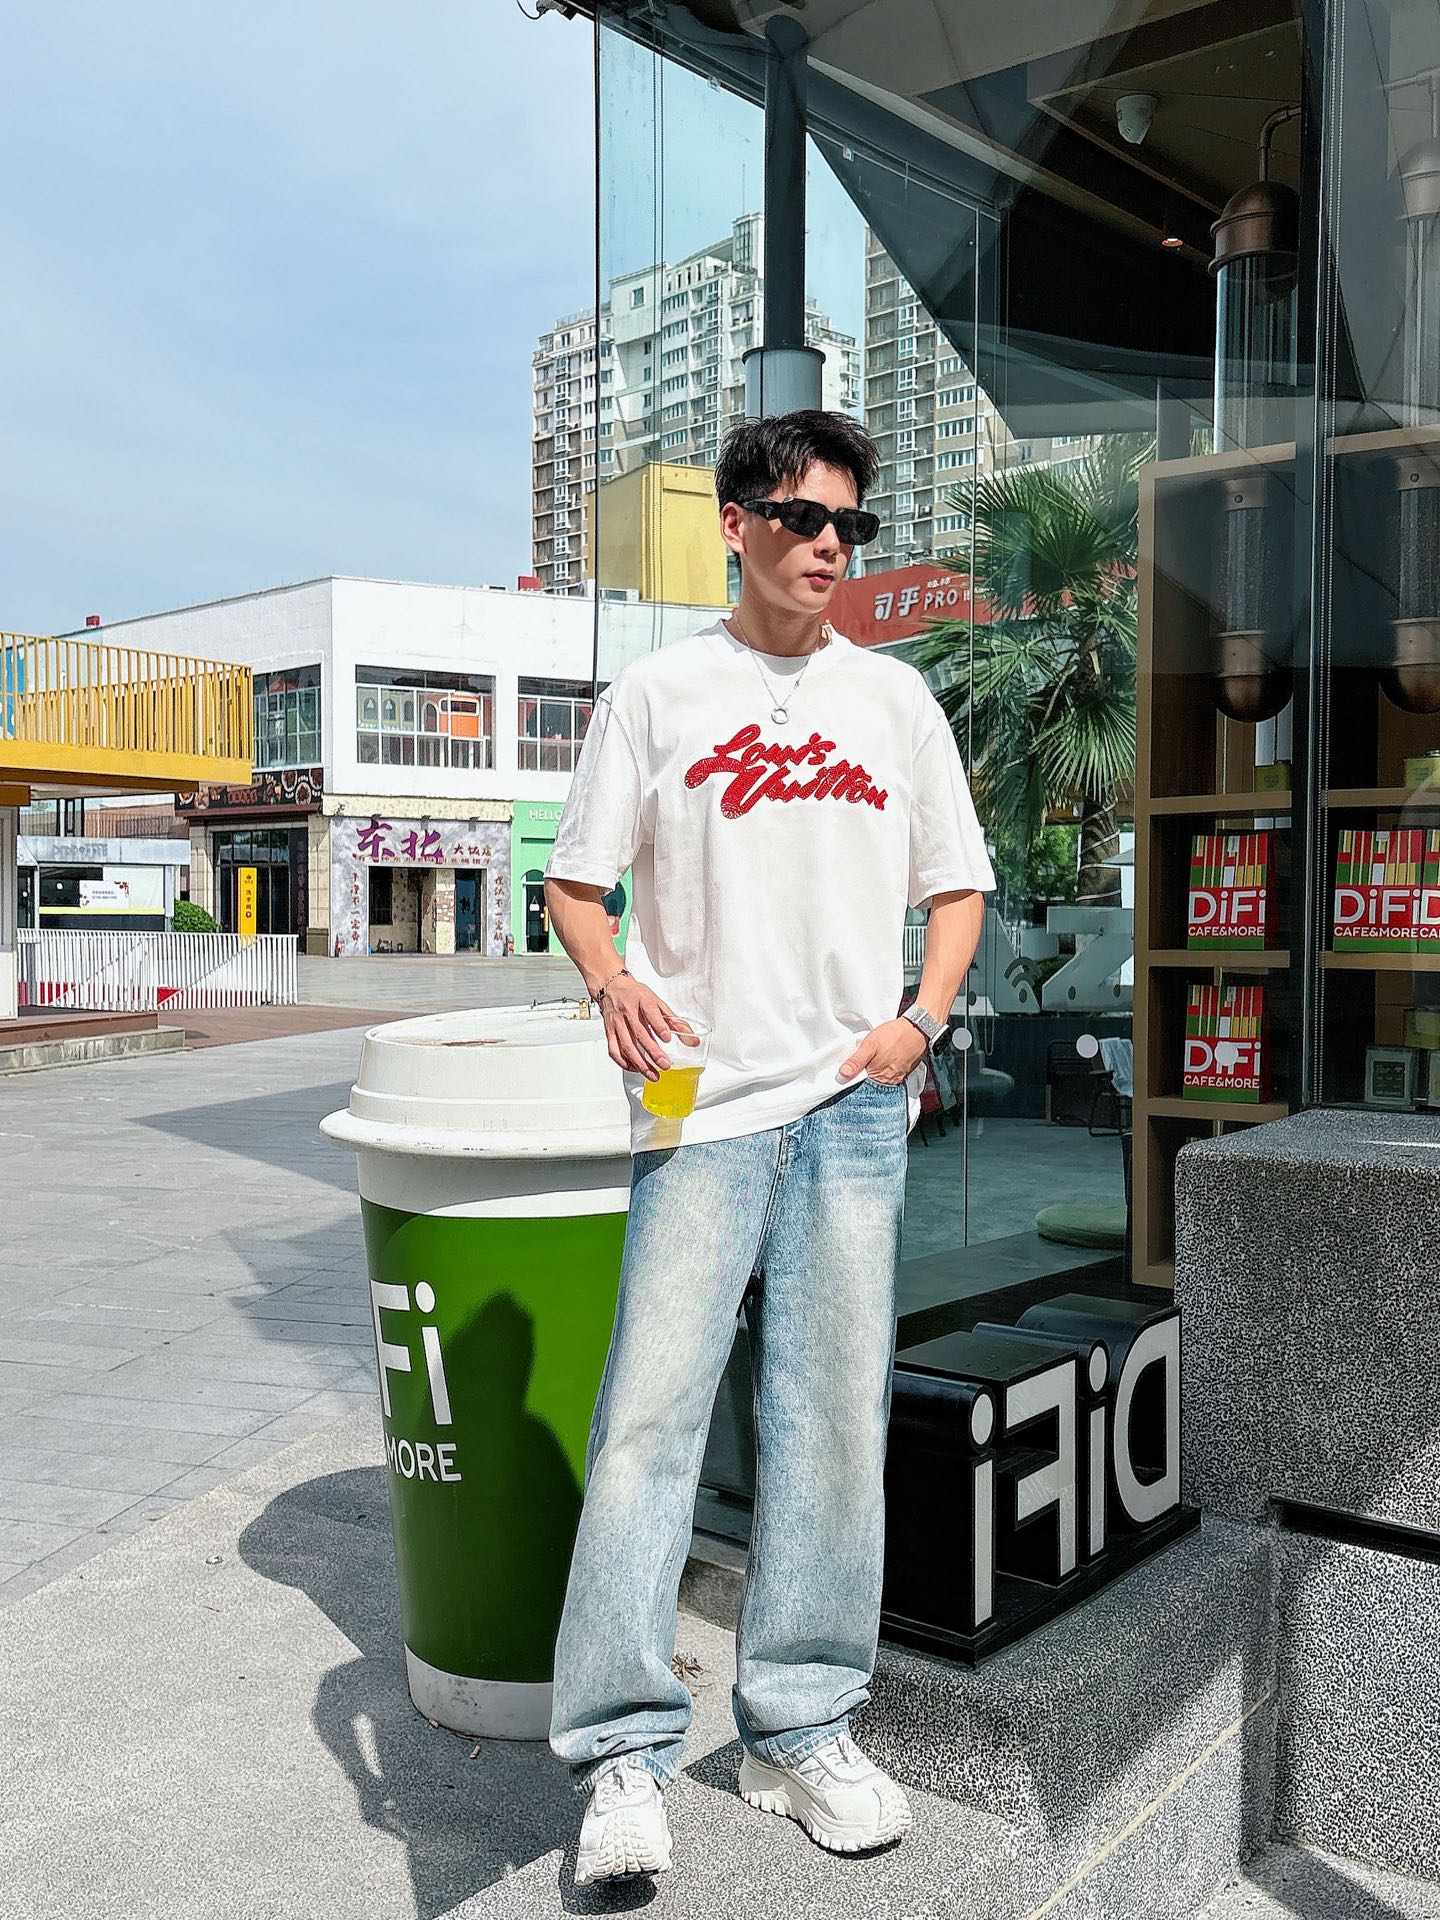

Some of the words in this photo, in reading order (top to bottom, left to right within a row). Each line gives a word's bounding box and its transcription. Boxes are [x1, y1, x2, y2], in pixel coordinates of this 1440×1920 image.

[924, 588, 958, 611] PRO
[684, 723, 836, 789] Louis
[720, 759, 888, 819] Vuitton
[356, 817, 443, 864] 东北
[453, 843, 491, 856] 大饭店
[1188, 889, 1266, 924] DiFi
[1334, 888, 1420, 924] DiFi
[1188, 926, 1265, 937] CAFE&MORE
[1334, 926, 1419, 938] CAFE&MORE
[1184, 1075, 1260, 1089] CAFE&MORE
